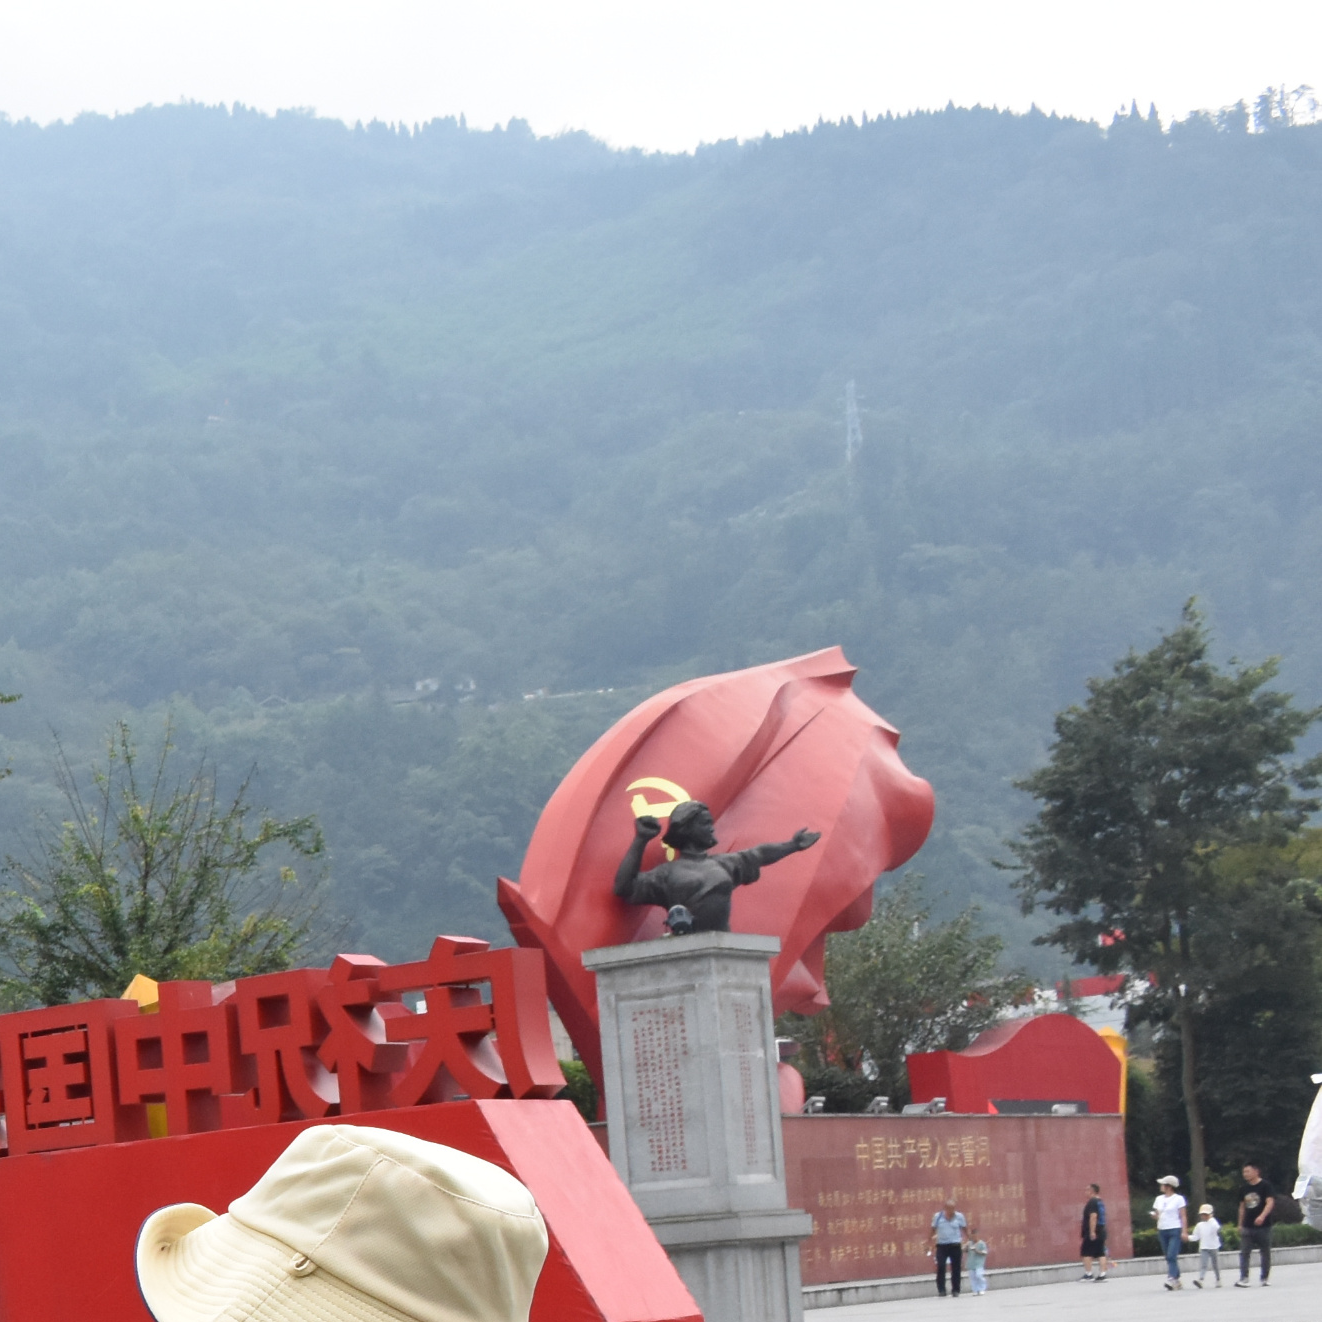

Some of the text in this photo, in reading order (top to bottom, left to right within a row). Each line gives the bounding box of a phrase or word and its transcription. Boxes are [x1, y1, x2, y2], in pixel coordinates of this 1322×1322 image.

[855, 1136, 991, 1171] 中国共产党入党誓词
